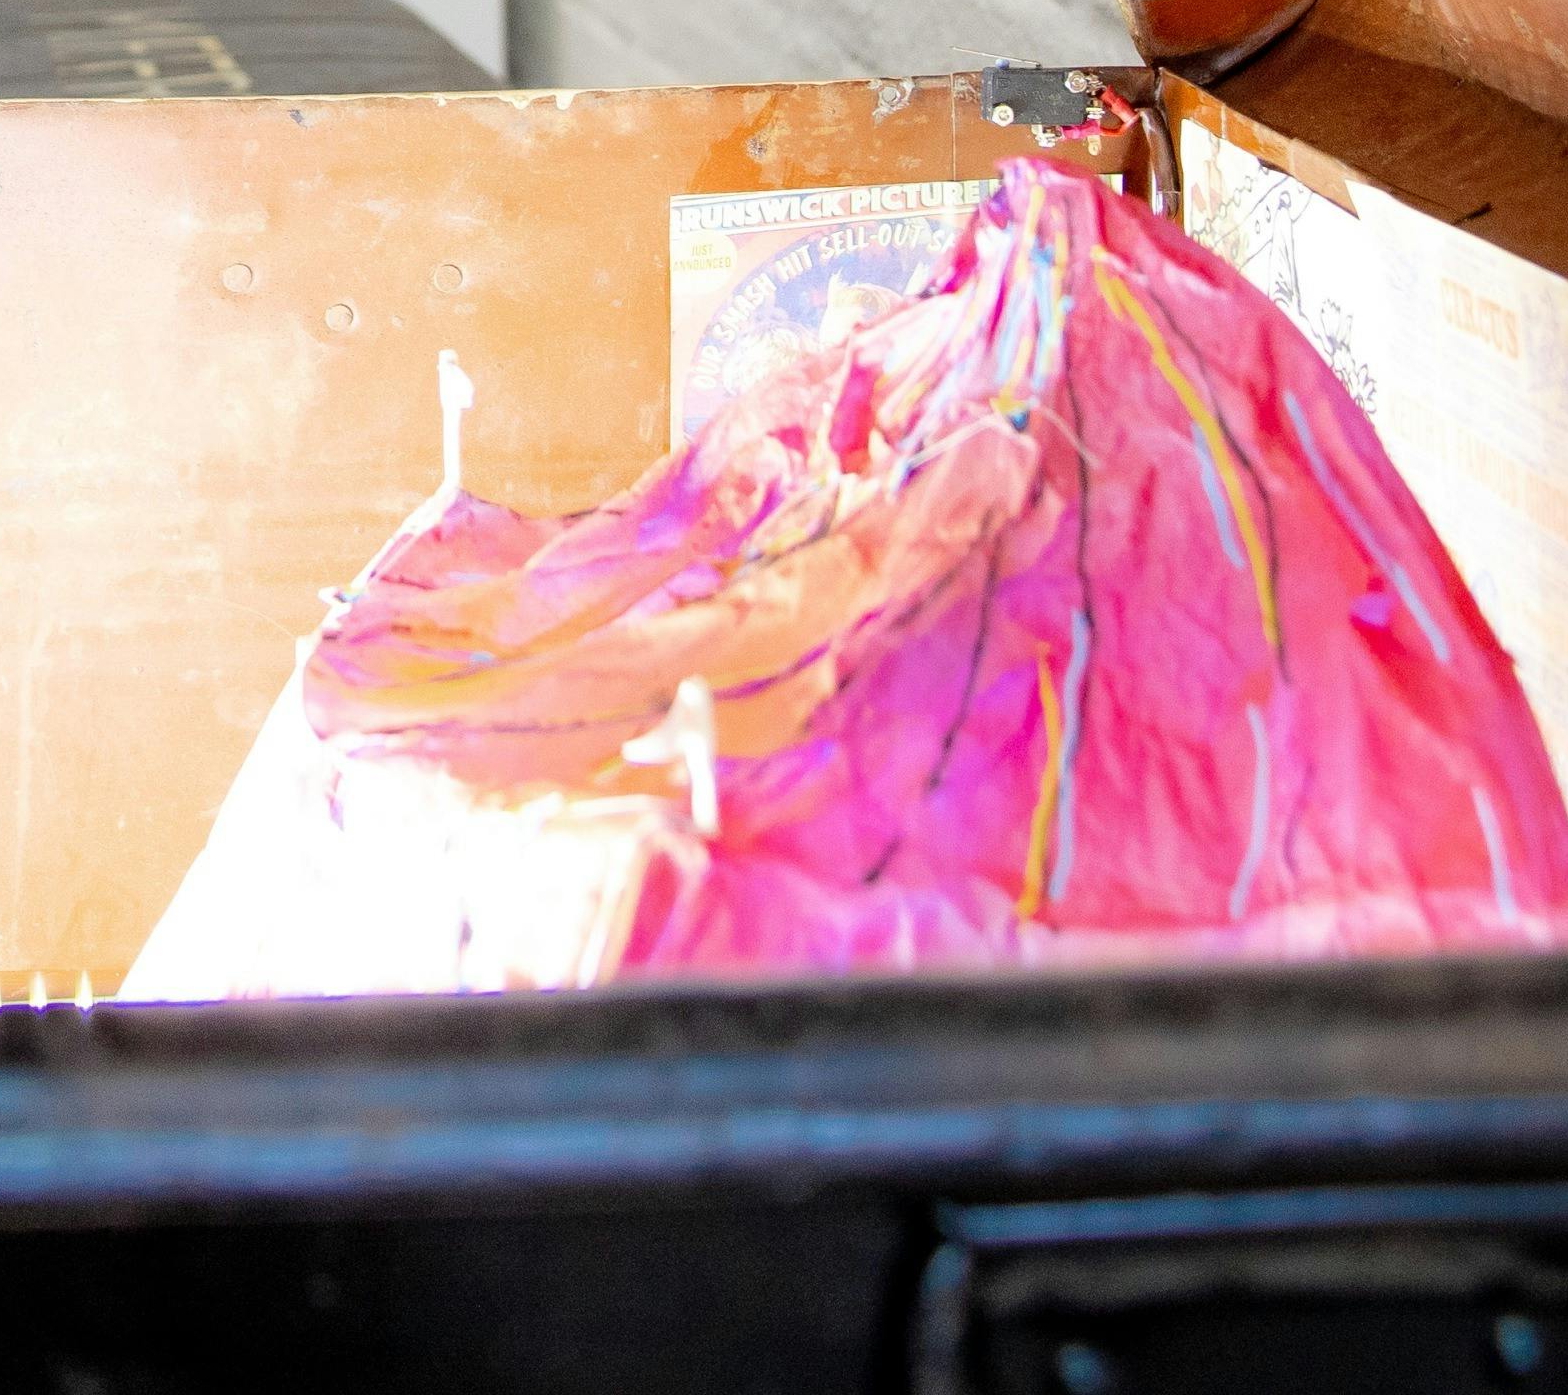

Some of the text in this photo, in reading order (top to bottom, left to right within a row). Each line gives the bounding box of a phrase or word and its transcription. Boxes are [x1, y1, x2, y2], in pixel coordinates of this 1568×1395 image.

[850, 179, 981, 216] PICTURE
[691, 243, 713, 256] JUST
[692, 344, 724, 389] OUR
[712, 272, 778, 343] SMASH
[775, 244, 813, 283] HIT
[820, 222, 926, 260] SELL-OUT
[1439, 276, 1519, 360] CIRCUS
